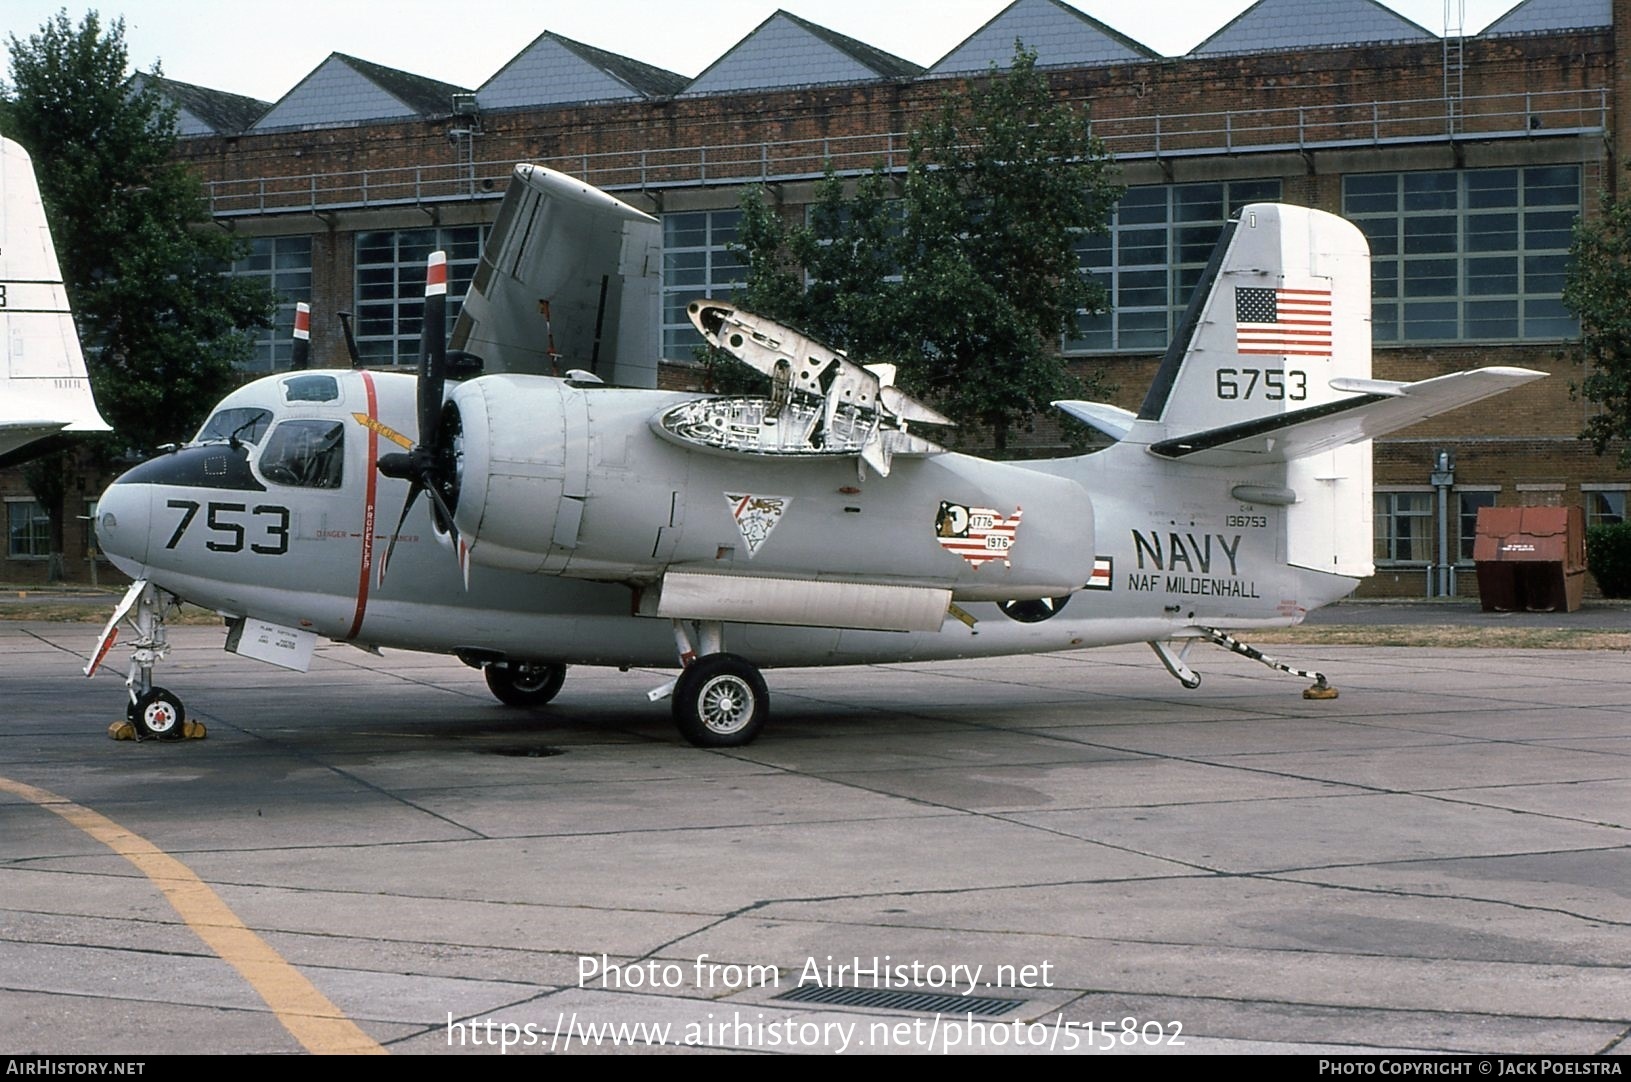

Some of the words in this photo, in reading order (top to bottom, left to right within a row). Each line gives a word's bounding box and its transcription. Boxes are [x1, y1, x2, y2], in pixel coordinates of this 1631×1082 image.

[1216, 368, 1307, 401] 6753
[165, 500, 290, 556] 753
[316, 530, 346, 538] DANGER
[973, 516, 993, 527] 1776
[1225, 515, 1267, 528] 136753
[363, 504, 374, 569] PROPELLER
[987, 537, 1008, 548] 1976
[1131, 529, 1242, 576] NAVY
[1128, 573, 1161, 592] NAF
[1166, 575, 1260, 599] MILDENHALL
